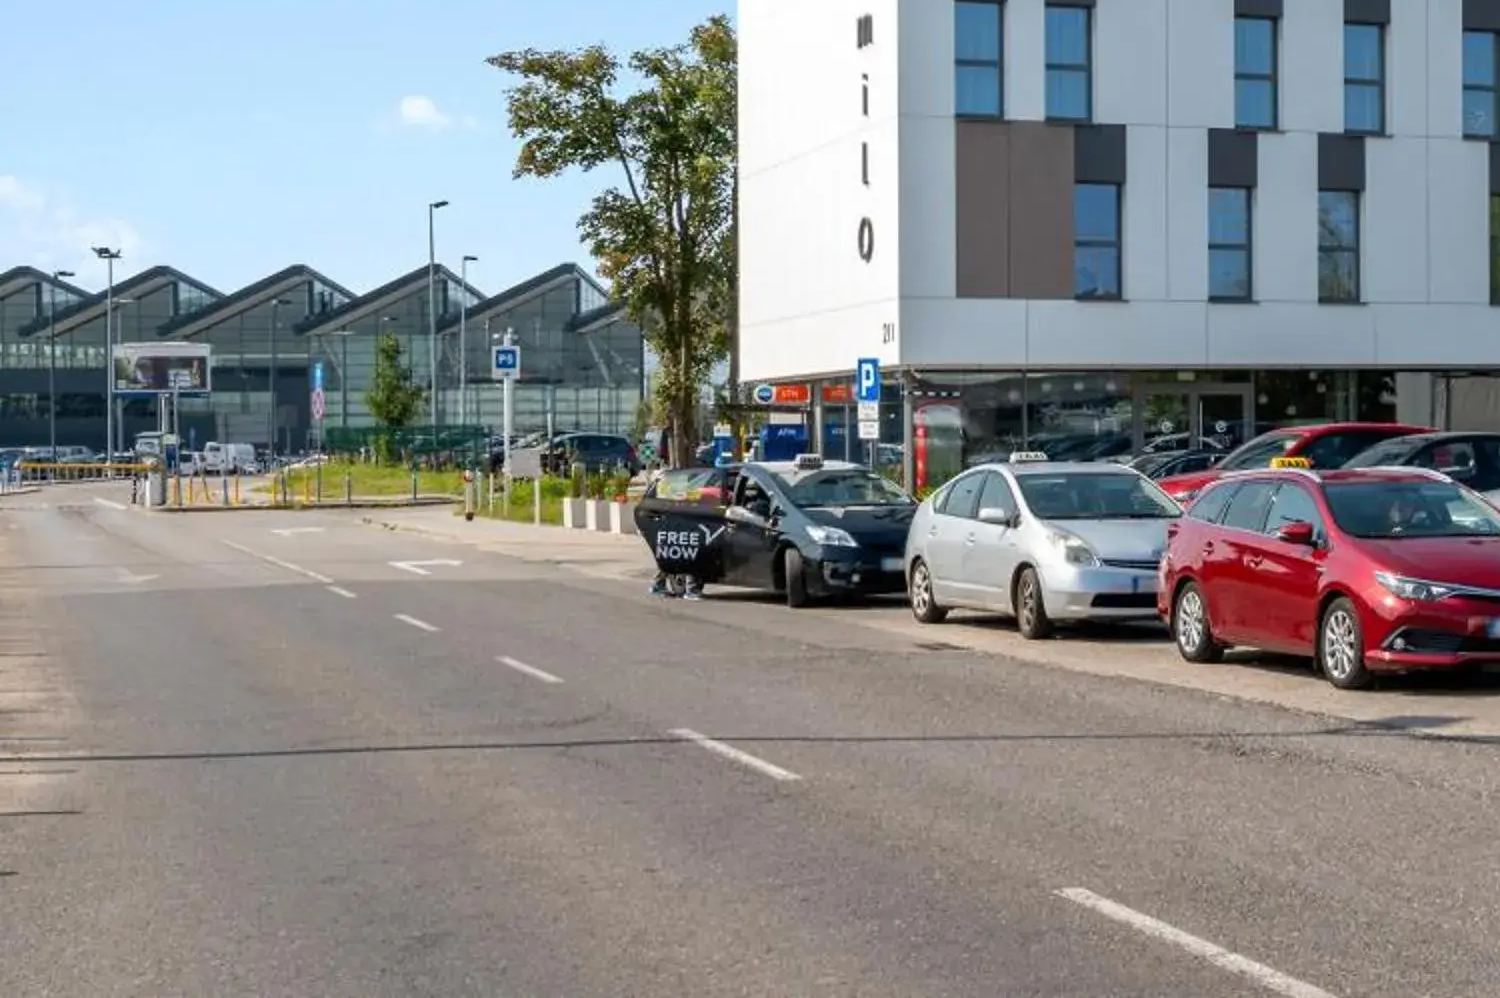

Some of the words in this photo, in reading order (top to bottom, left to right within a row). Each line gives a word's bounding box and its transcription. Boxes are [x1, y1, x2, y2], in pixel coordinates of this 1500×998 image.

[861, 363, 874, 397] P
[657, 531, 700, 545] FREE
[655, 545, 699, 560] NOW
